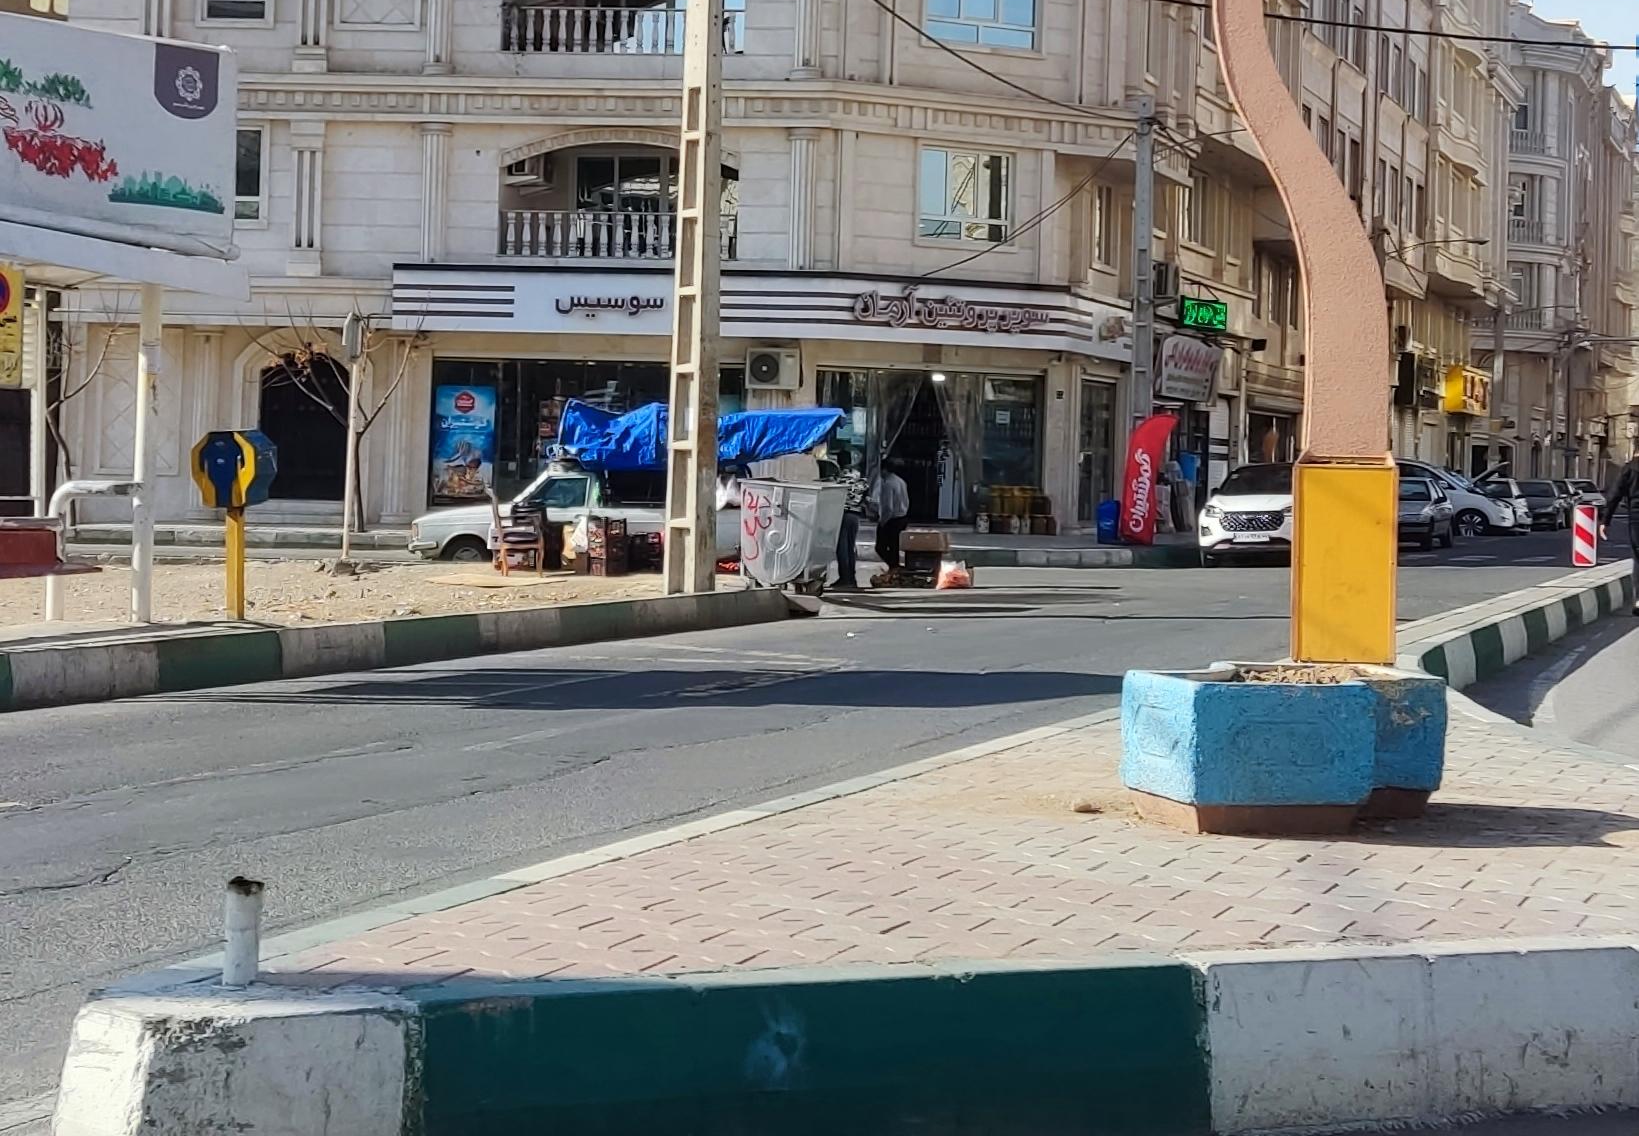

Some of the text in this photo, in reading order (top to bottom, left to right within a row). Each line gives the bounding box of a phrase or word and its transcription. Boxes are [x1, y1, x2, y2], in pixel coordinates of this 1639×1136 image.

[554, 295, 665, 318] سوسیس
[853, 285, 1050, 334] سوپر پروتئین آرمان
